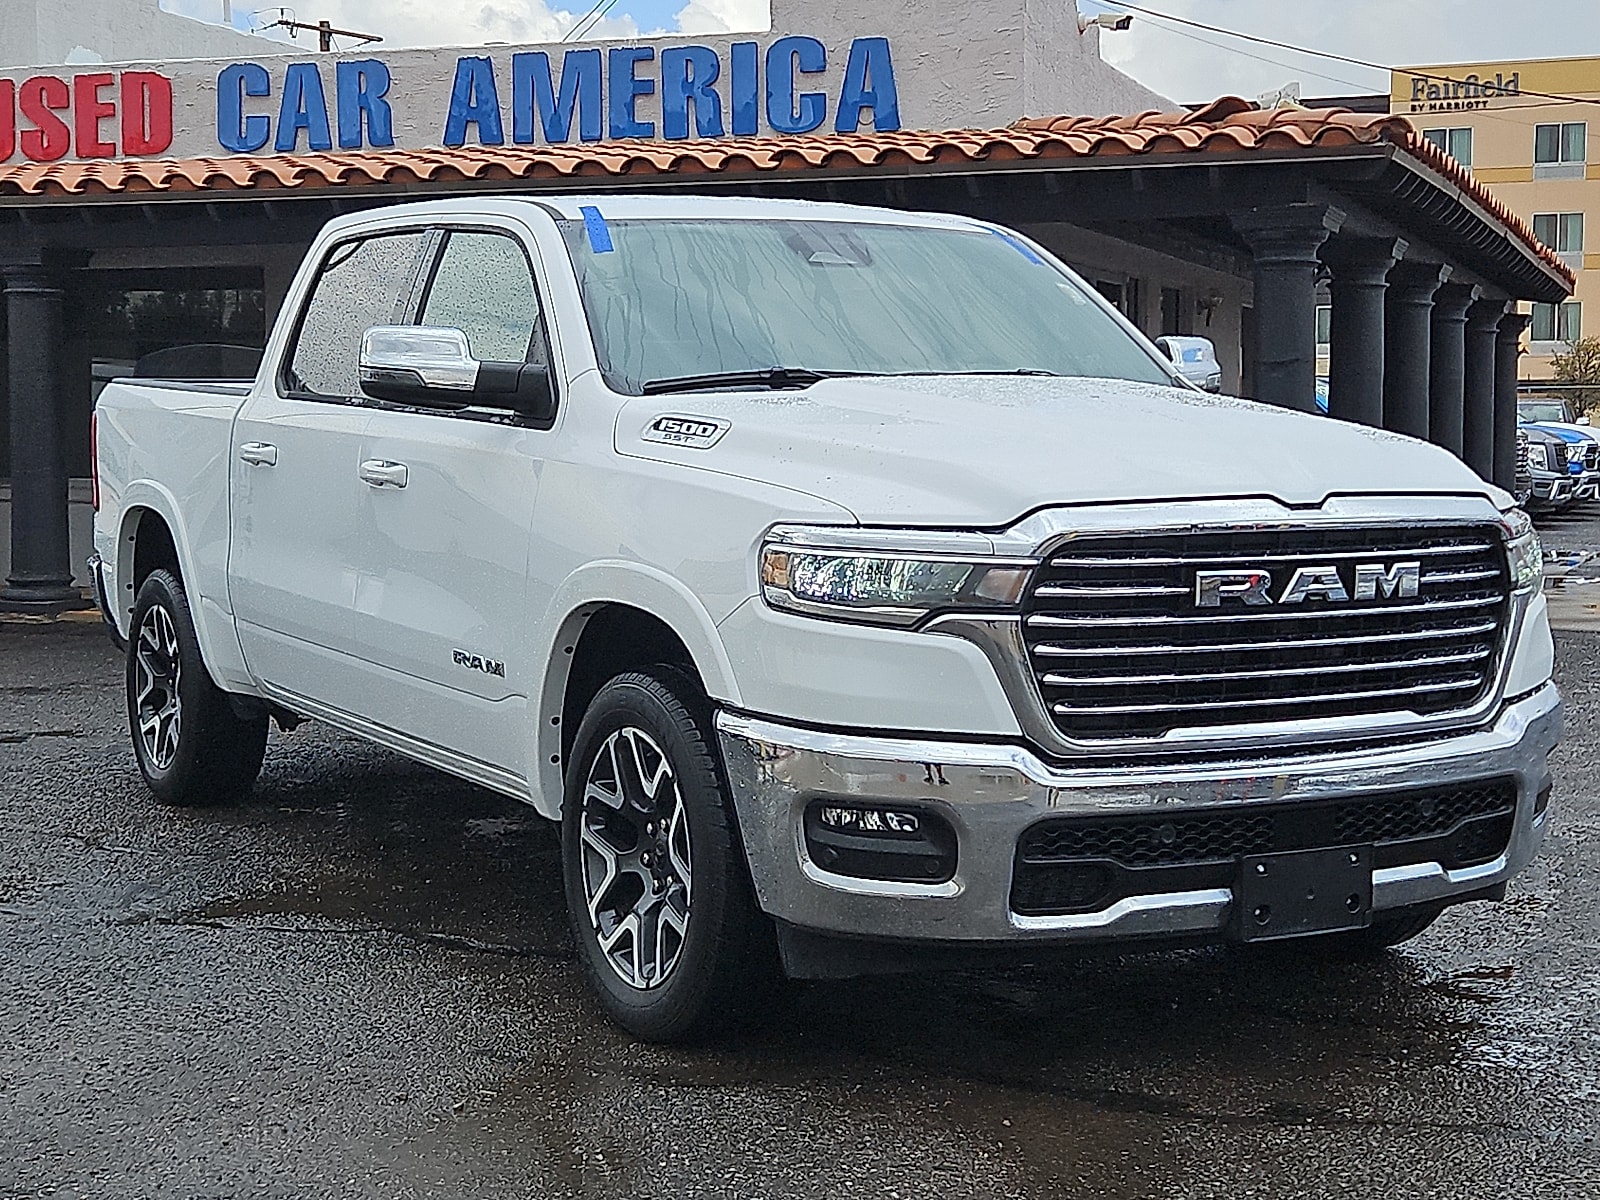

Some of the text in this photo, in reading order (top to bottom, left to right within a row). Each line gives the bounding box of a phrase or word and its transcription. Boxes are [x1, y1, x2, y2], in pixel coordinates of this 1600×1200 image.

[217, 58, 394, 153] CAR
[443, 35, 901, 147] AMERICA
[1410, 72, 1520, 101] Fairfield
[1411, 100, 1489, 112] BY MARRIOTT
[658, 418, 716, 437] 1500
[663, 433, 695, 443] SST
[1195, 561, 1421, 607] RAM
[452, 648, 506, 679] RAM
